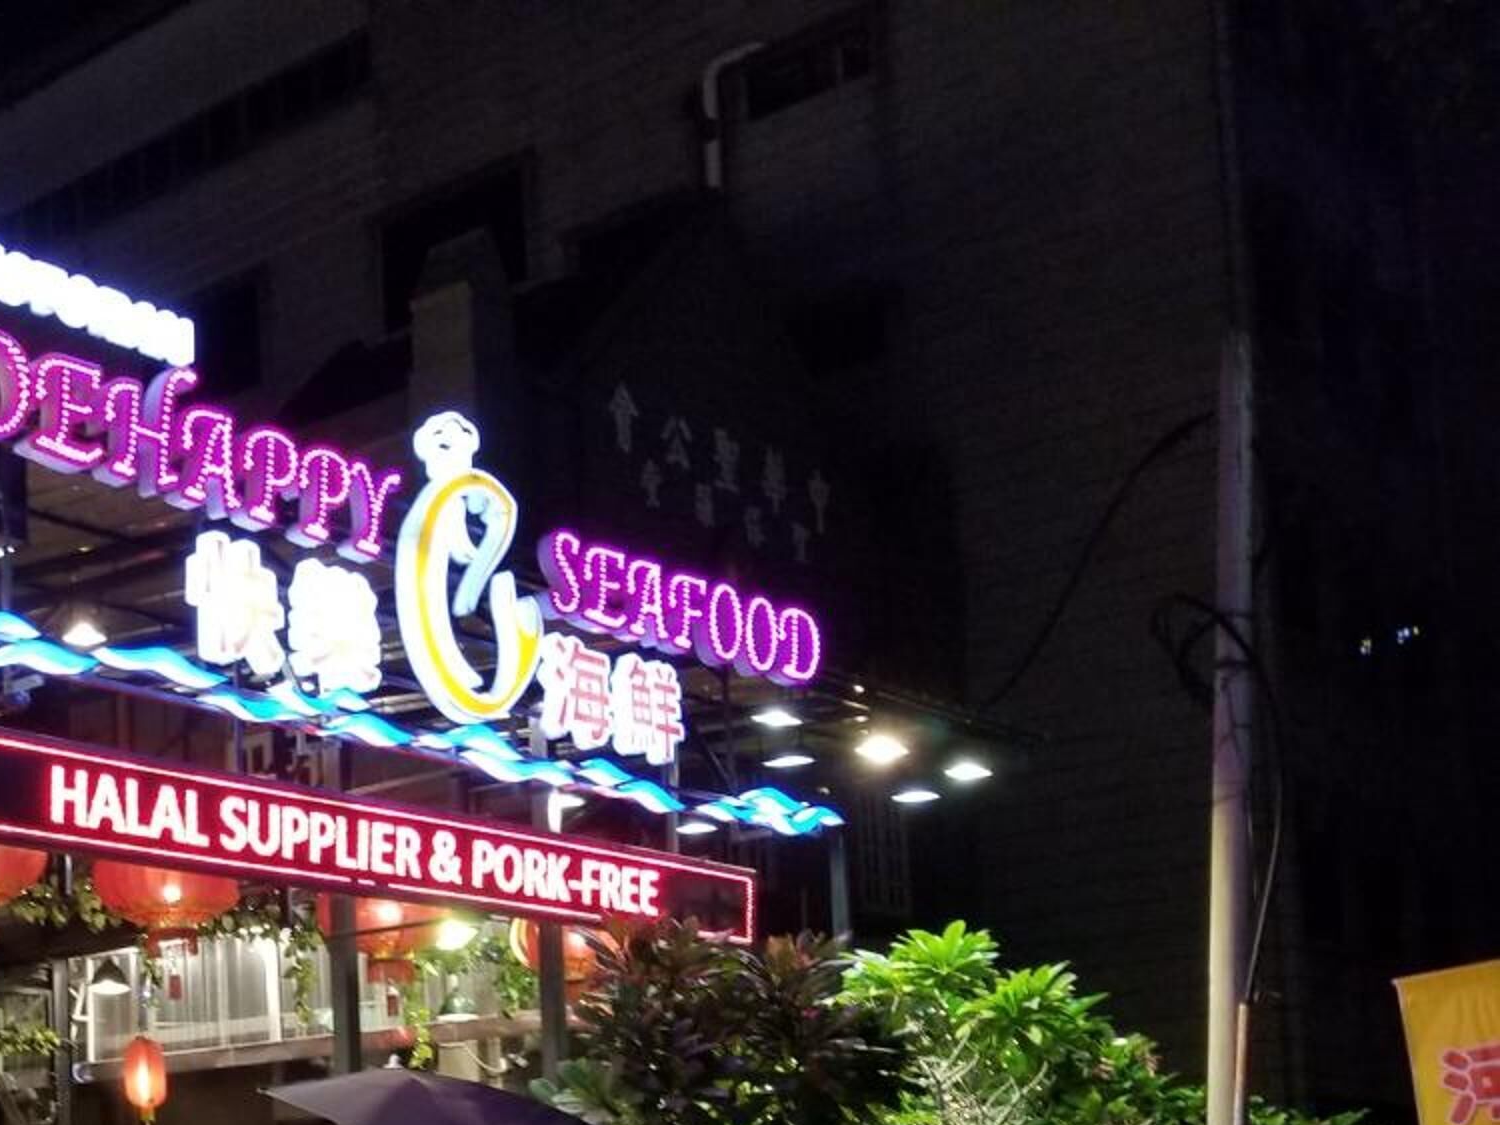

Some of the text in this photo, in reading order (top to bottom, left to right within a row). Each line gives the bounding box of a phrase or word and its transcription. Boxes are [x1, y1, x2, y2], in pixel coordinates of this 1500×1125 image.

[544, 530, 821, 684] SEAFOOD
[47, 764, 661, 917] HALAL SUPPLIER & PORK-FREE
